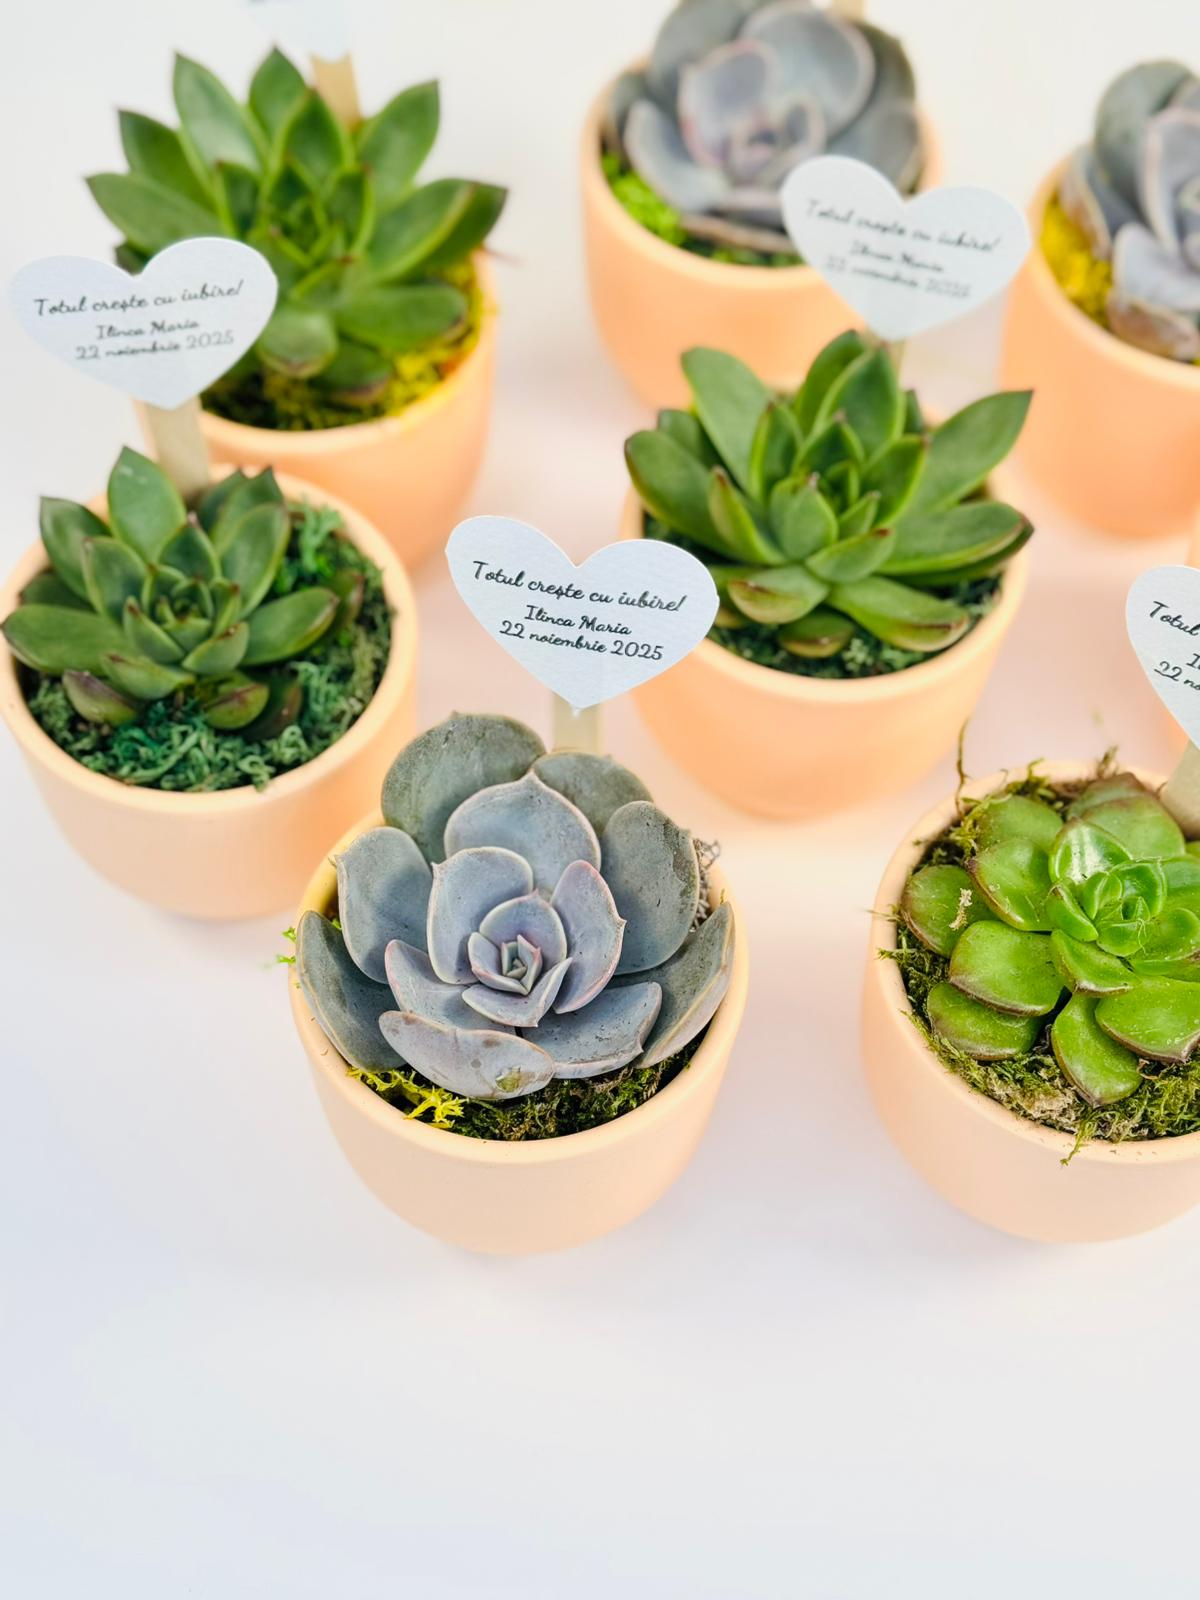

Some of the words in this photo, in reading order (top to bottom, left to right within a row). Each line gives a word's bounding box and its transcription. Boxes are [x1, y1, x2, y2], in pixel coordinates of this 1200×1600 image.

[33, 296, 88, 317] Totul
[154, 293, 176, 306] cu
[181, 279, 244, 302] iubire!
[75, 345, 100, 361] 22
[105, 341, 181, 357] noiembrie
[186, 330, 235, 350] 2025
[96, 324, 145, 340] Ilinca
[150, 319, 200, 335] Maria
[473, 560, 525, 588] Totul
[589, 590, 614, 604] cu
[618, 590, 687, 612] iubire!
[524, 604, 576, 628] Ilinca
[578, 615, 632, 636] Maria
[499, 620, 525, 639] 22
[529, 630, 607, 654] noiembrie
[610, 639, 665, 661] 2025
[1154, 660, 1183, 682] 22
